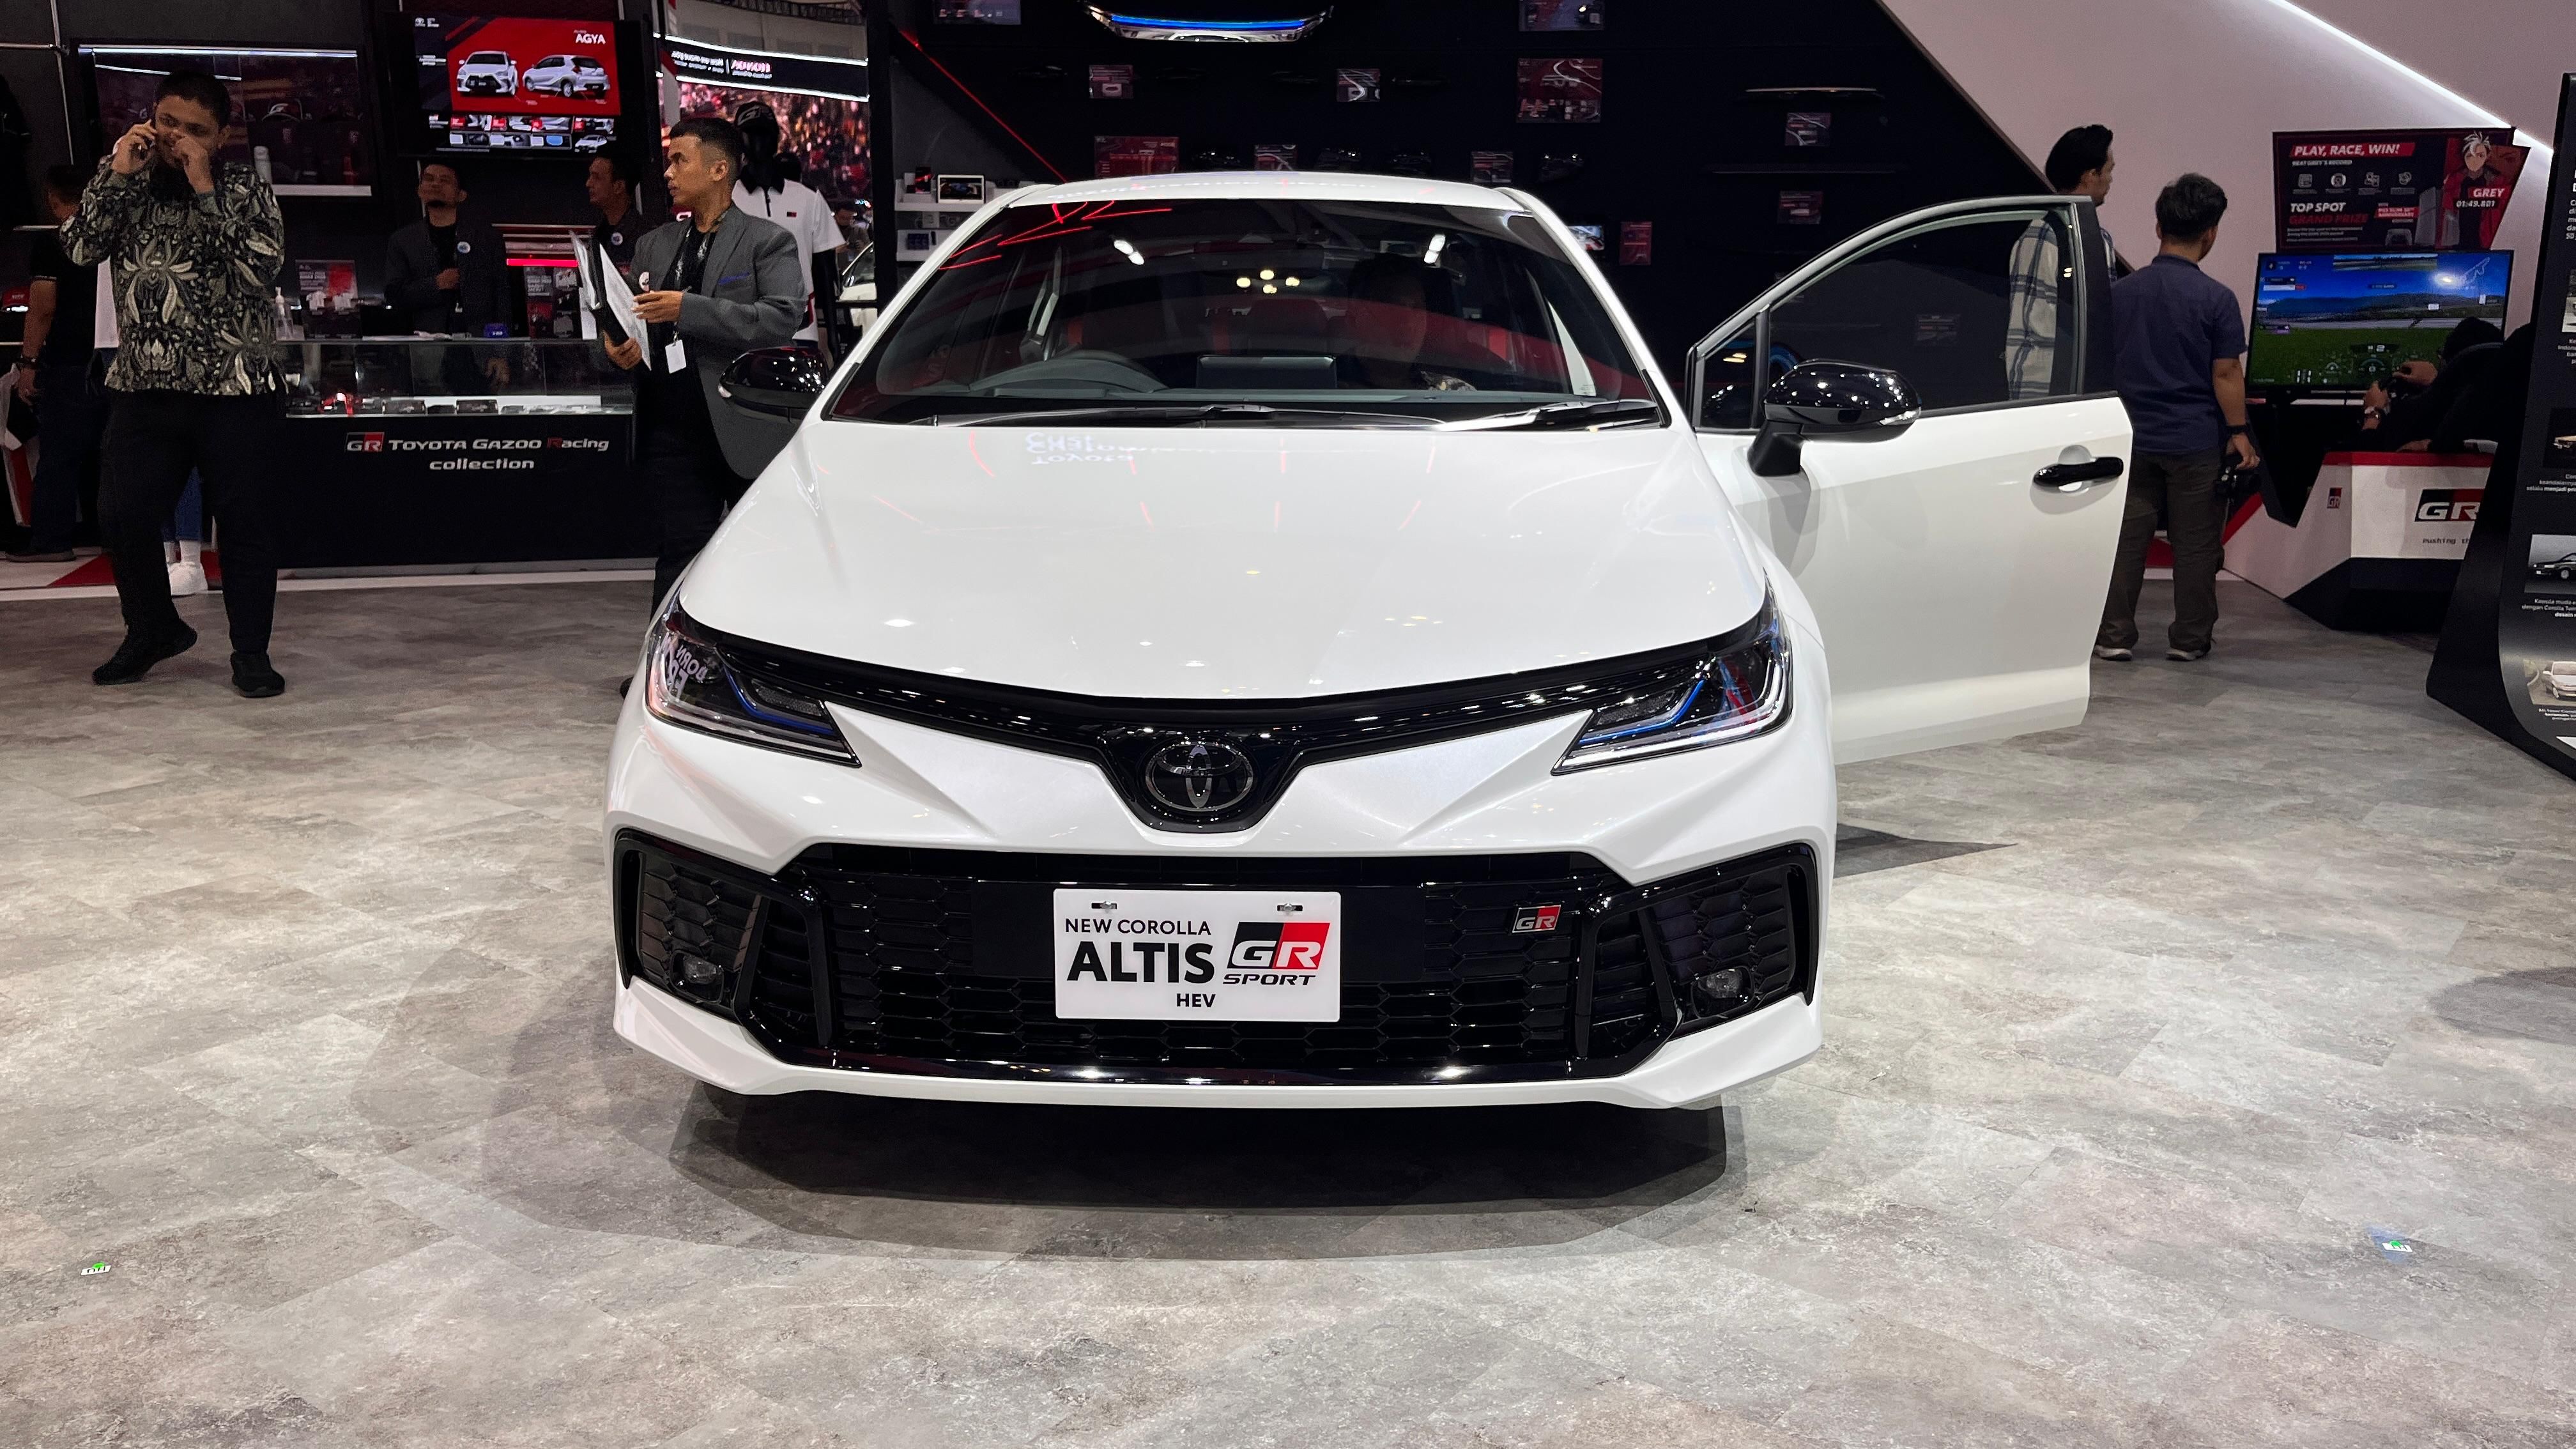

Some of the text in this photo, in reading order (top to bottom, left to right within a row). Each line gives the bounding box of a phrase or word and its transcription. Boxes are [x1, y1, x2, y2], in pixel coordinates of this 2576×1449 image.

[575, 33, 606, 45] AGYA
[2294, 144, 2400, 157] PLAY, RACE, WIN!
[2472, 188, 2505, 198] GREY
[2290, 202, 2347, 212] TOP SPOT
[2289, 213, 2369, 224] GRAND PRIZE
[388, 439, 467, 450] TOYOTA
[472, 438, 542, 450] GAZOO
[547, 437, 609, 452] Racing
[429, 457, 535, 471] collection
[2418, 502, 2481, 520] GR
[1065, 918, 1211, 935] NEW COROLLA
[1066, 940, 1215, 985] ALTIS
[1223, 974, 1316, 986] SPORT
[1177, 993, 1216, 1008] HEV
